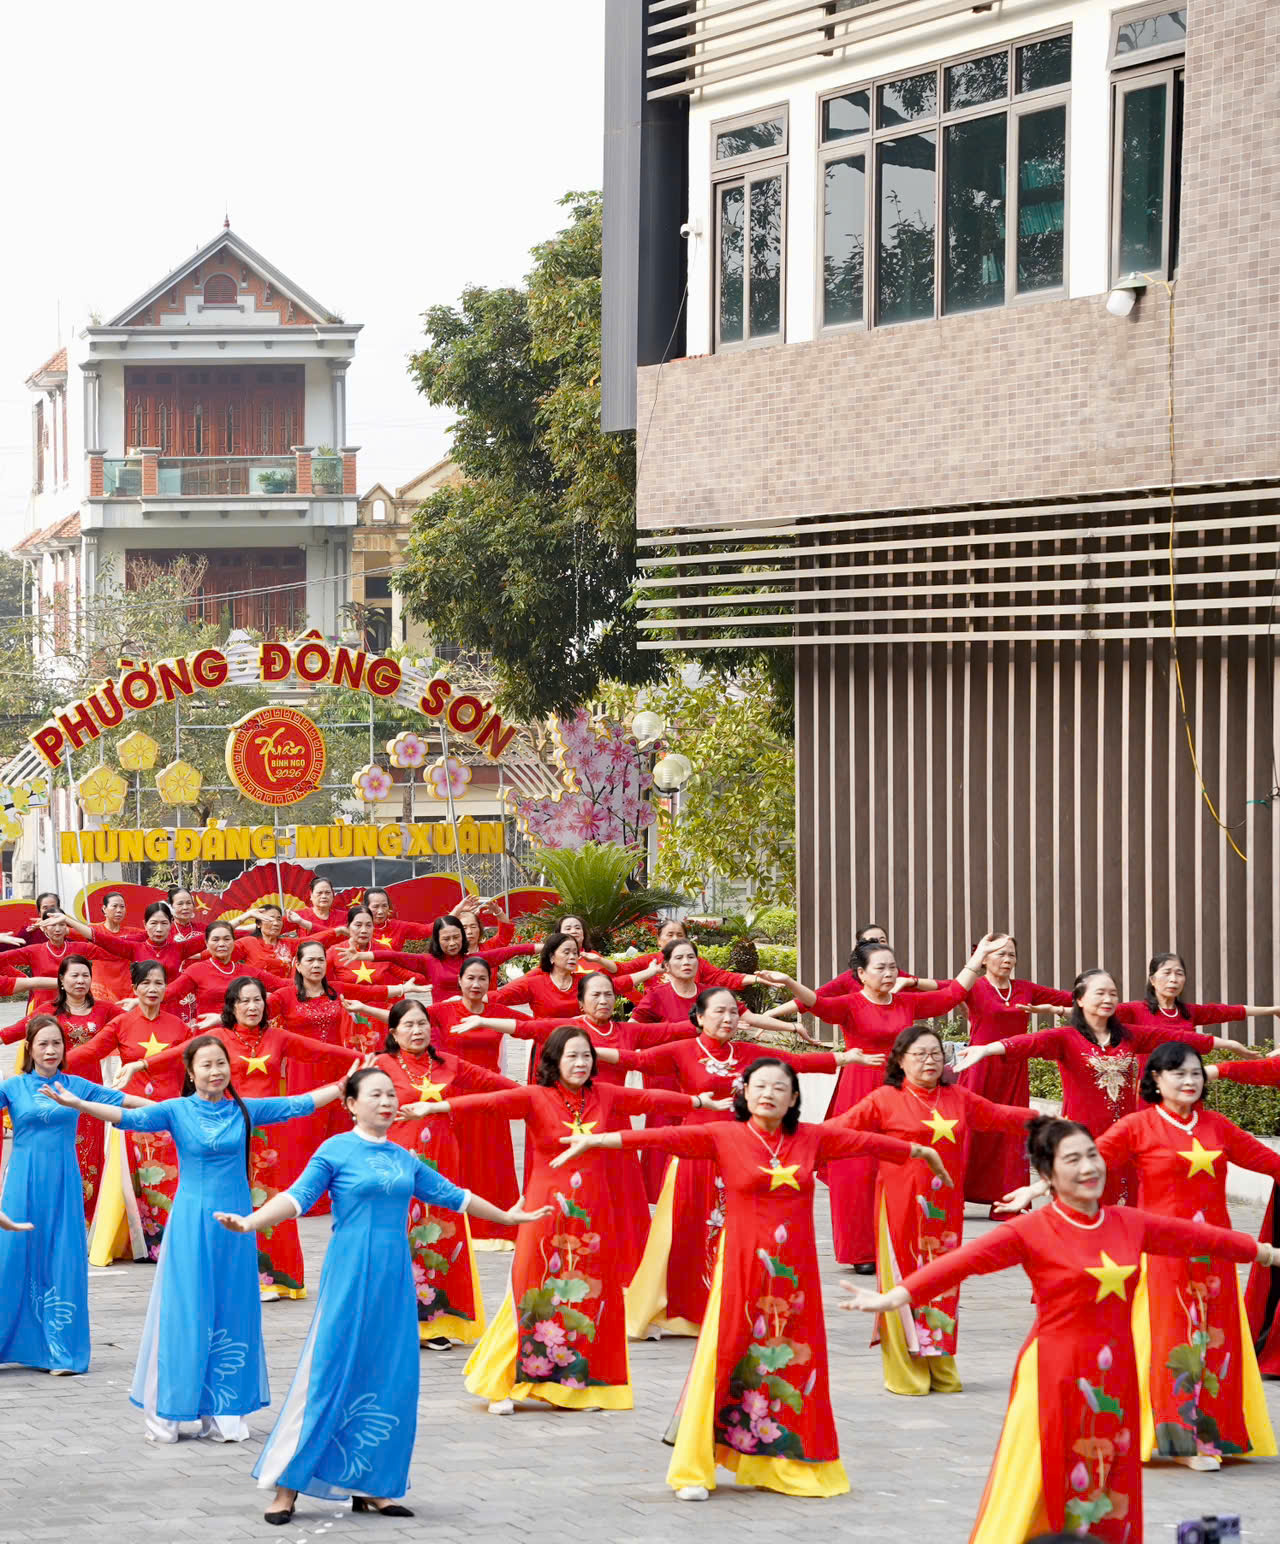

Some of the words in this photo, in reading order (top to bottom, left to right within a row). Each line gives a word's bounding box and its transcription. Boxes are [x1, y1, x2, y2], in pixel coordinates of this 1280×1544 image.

[31, 649, 229, 768] PHƯỜNG
[258, 629, 403, 697] ĐÔNG
[420, 678, 517, 760] SƠN
[274, 768, 304, 778] 2026
[60, 823, 170, 864] MỪNG
[175, 817, 276, 861] ĐẢNG
[296, 817, 403, 858] MỪNG
[407, 815, 505, 856] XUÂN
